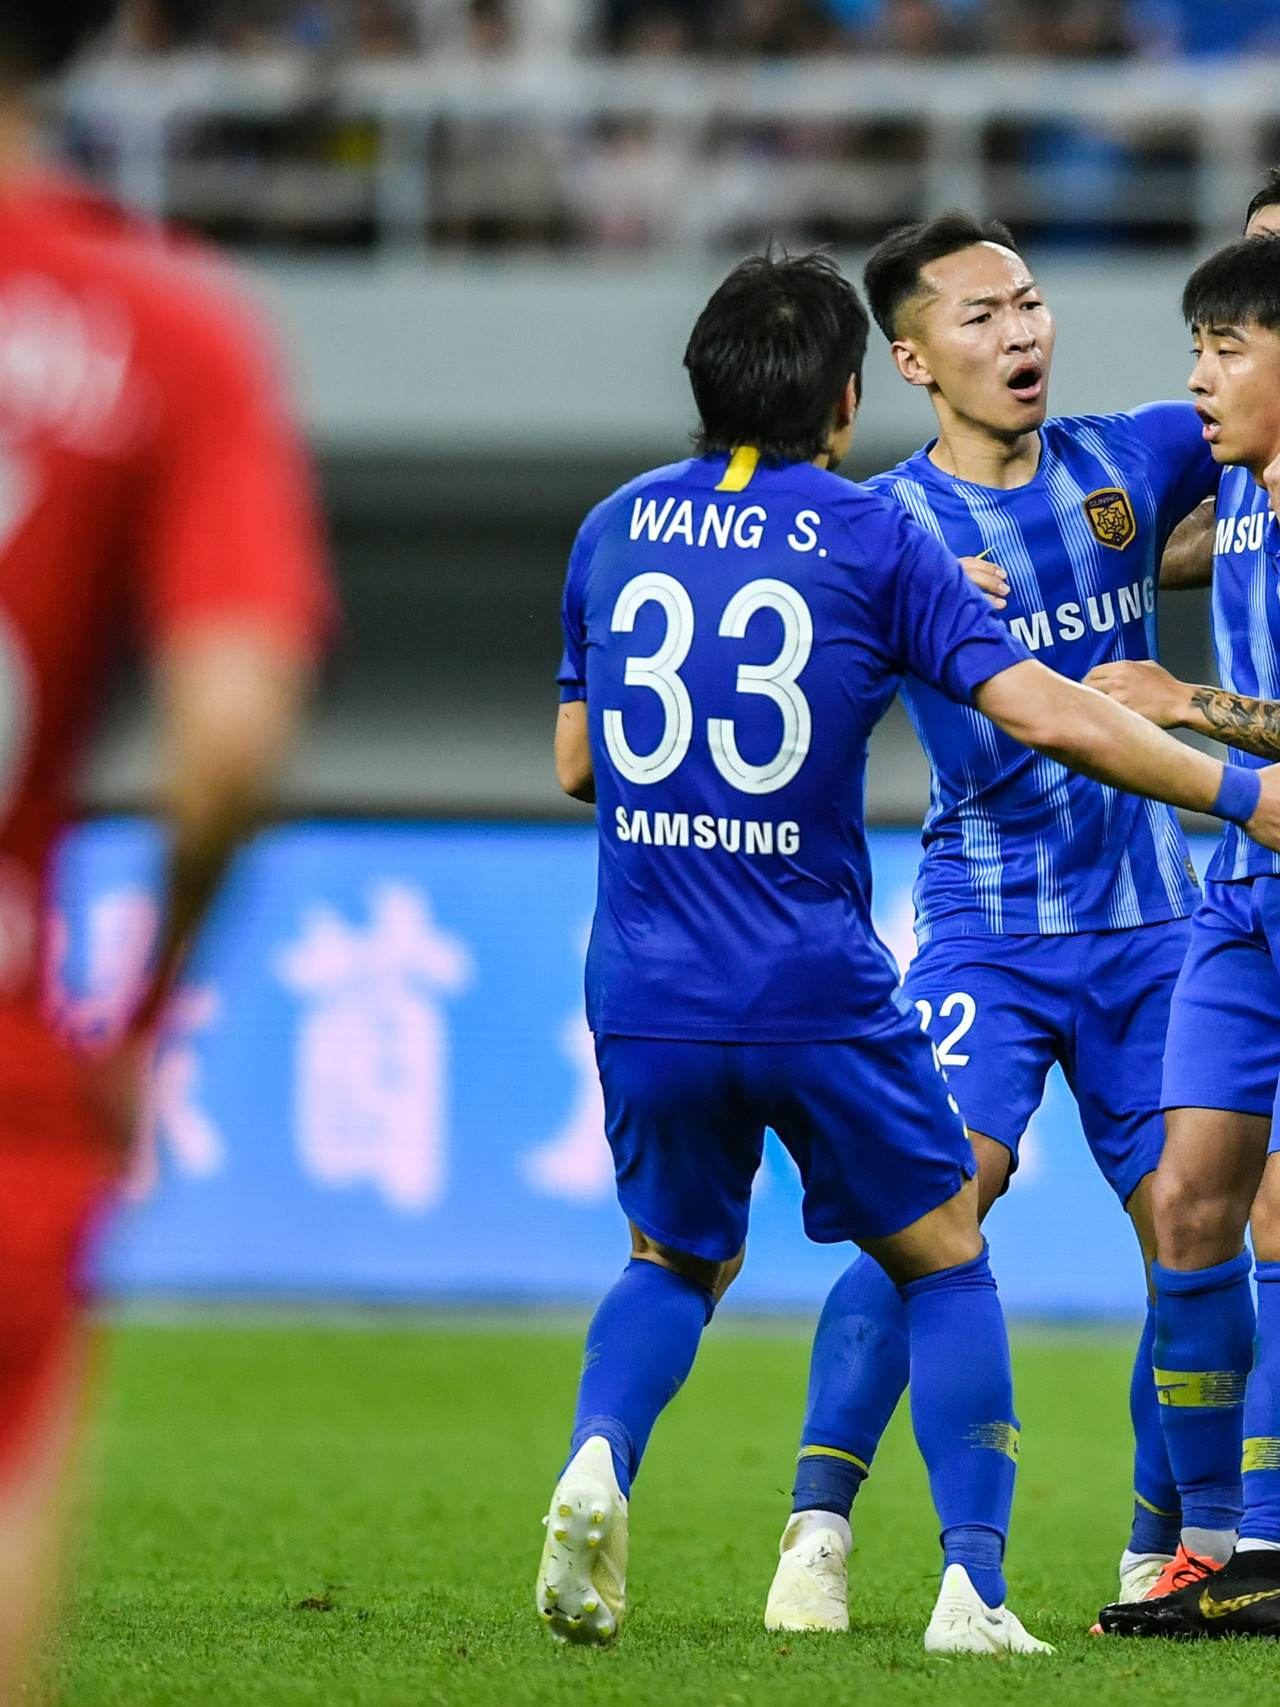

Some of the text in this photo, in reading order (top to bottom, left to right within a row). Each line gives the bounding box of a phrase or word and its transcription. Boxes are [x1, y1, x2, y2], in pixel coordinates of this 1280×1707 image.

[629, 497, 828, 558] WANG S.
[1212, 511, 1276, 555] MSU
[1009, 575, 1155, 651] MSUNG
[603, 572, 813, 795] 33
[615, 806, 801, 855] SAMSUNG
